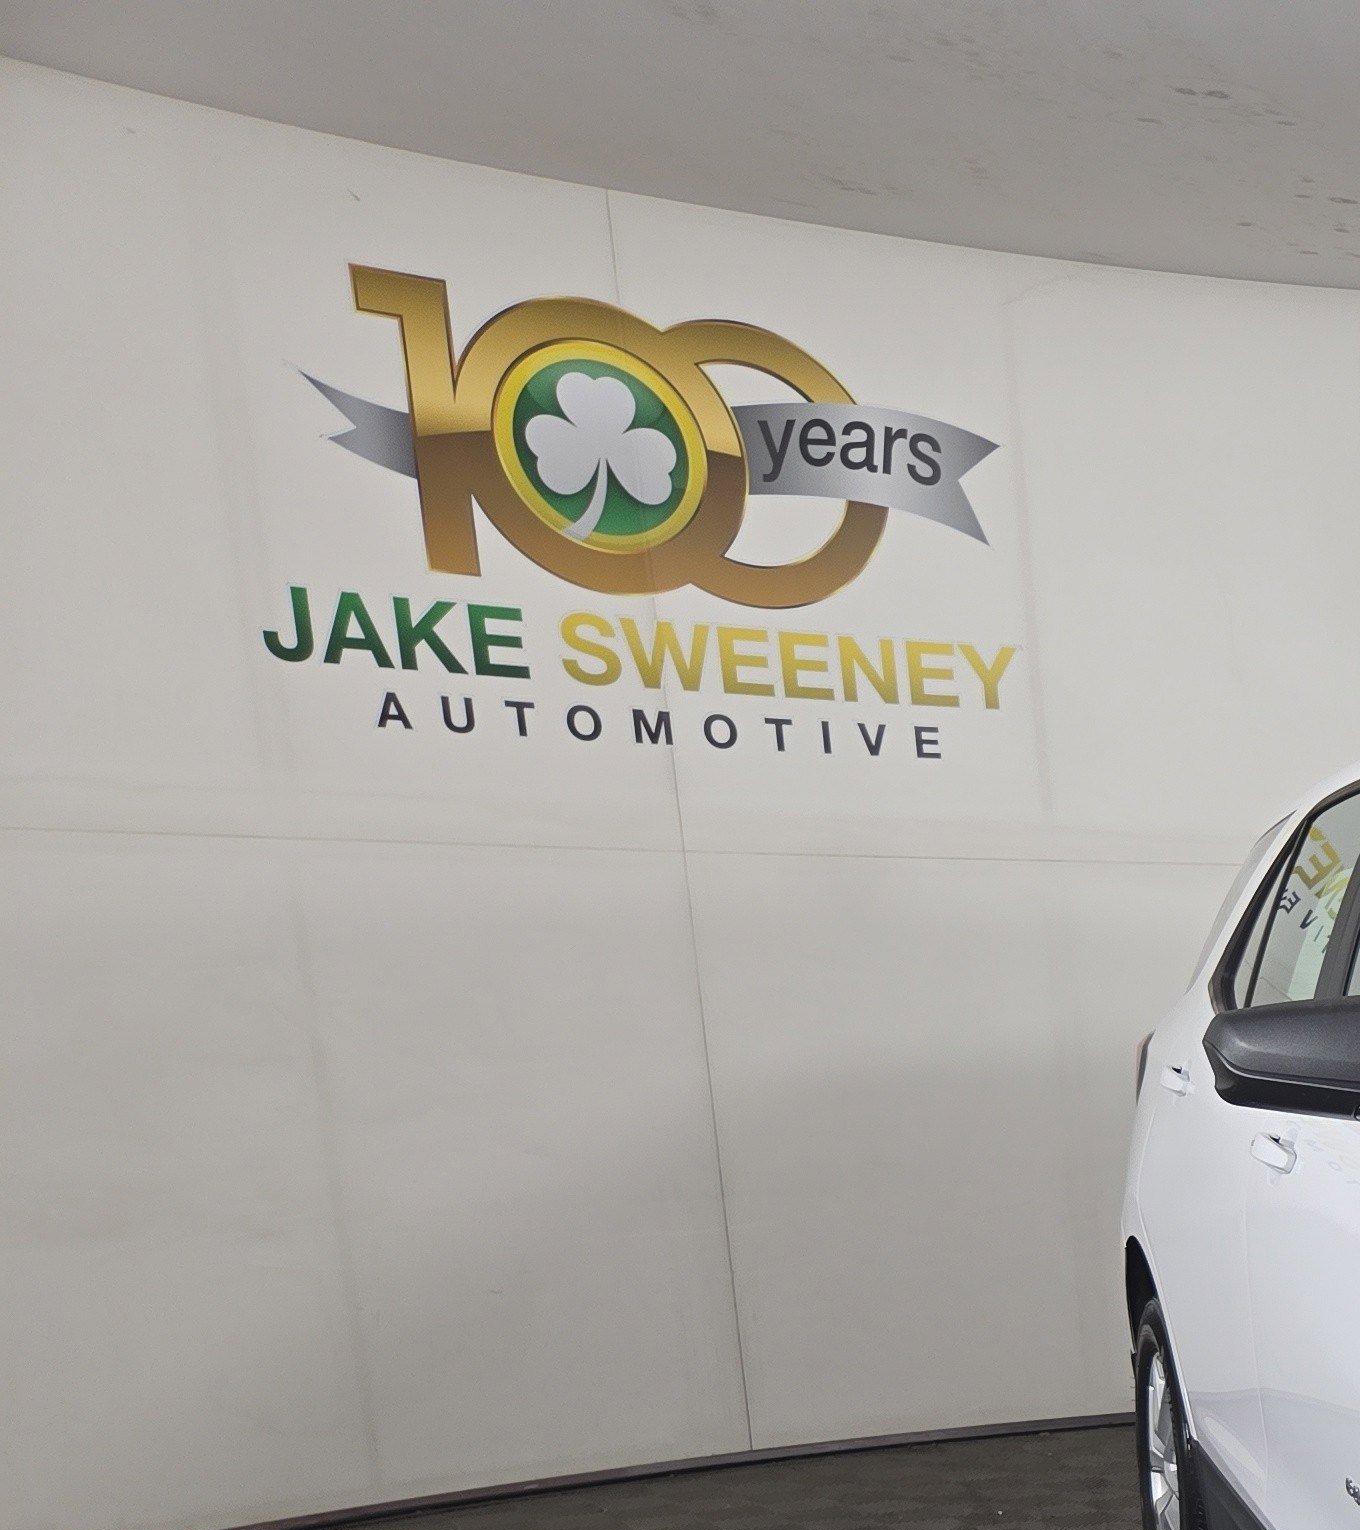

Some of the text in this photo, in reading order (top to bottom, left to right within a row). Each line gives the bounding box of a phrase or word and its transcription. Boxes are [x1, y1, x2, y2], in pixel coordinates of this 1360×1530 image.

[757, 417, 943, 487] years
[262, 584, 1016, 710] JAKE SWEENEY
[377, 690, 943, 760] AUTOMOTIVE
